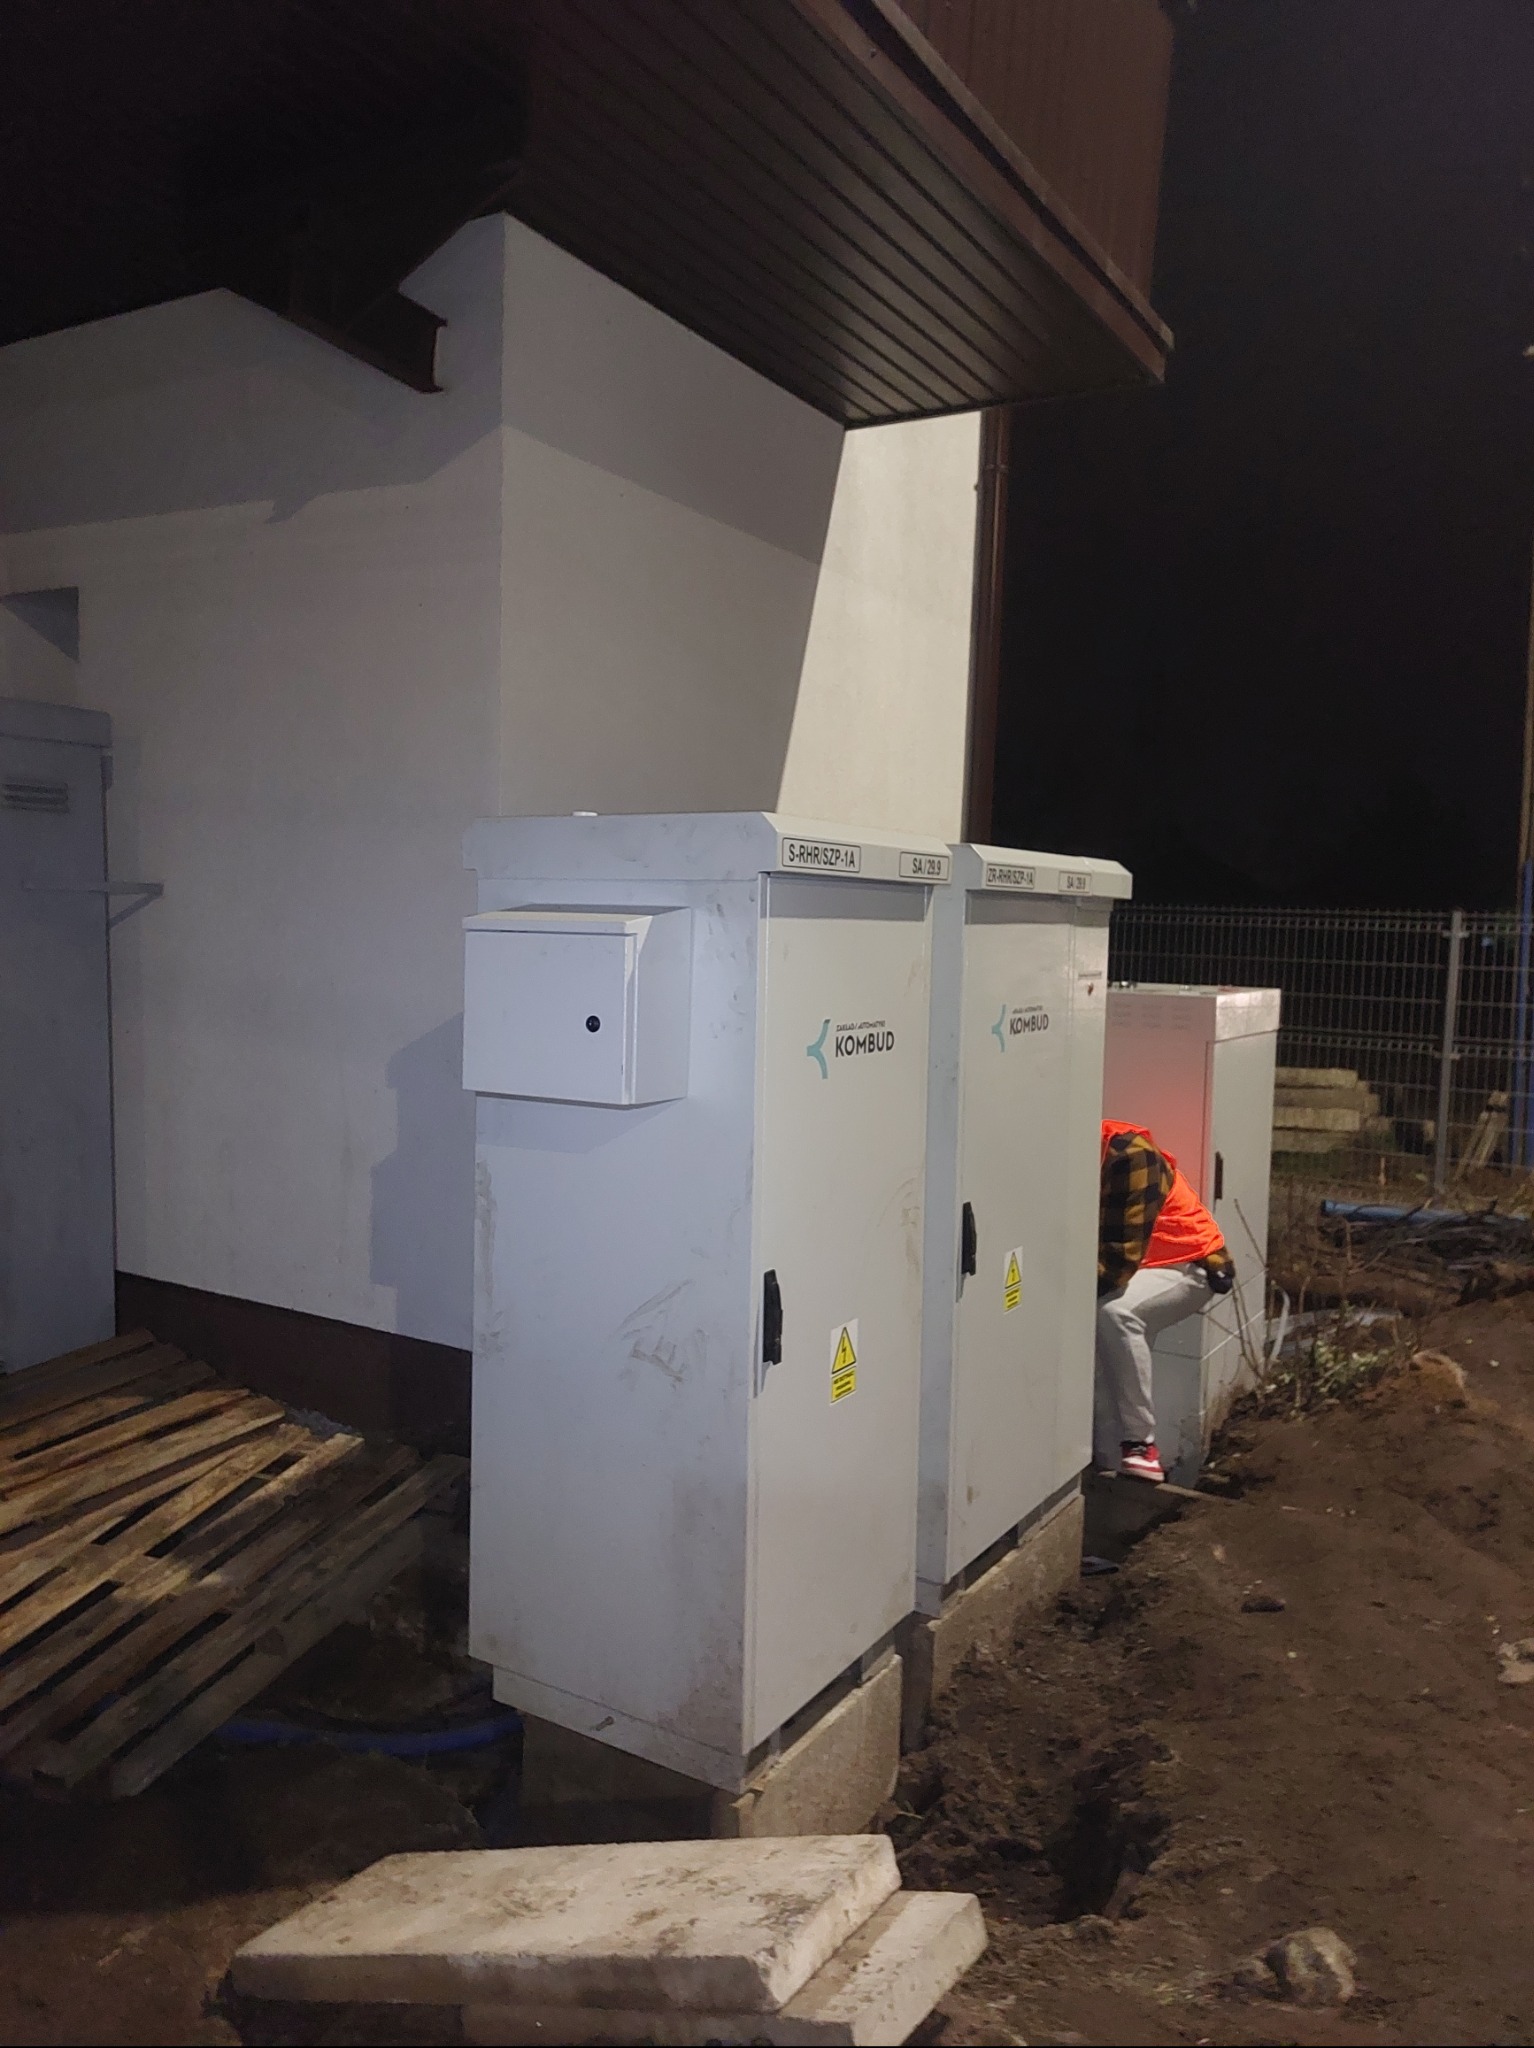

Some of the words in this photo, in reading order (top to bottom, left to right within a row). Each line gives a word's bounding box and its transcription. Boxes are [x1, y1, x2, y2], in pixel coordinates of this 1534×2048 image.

[788, 843, 856, 868] S-RHR/SZP-1A
[1009, 1013, 1049, 1035] KOMBUD
[835, 1031, 895, 1058] KOMBUD
